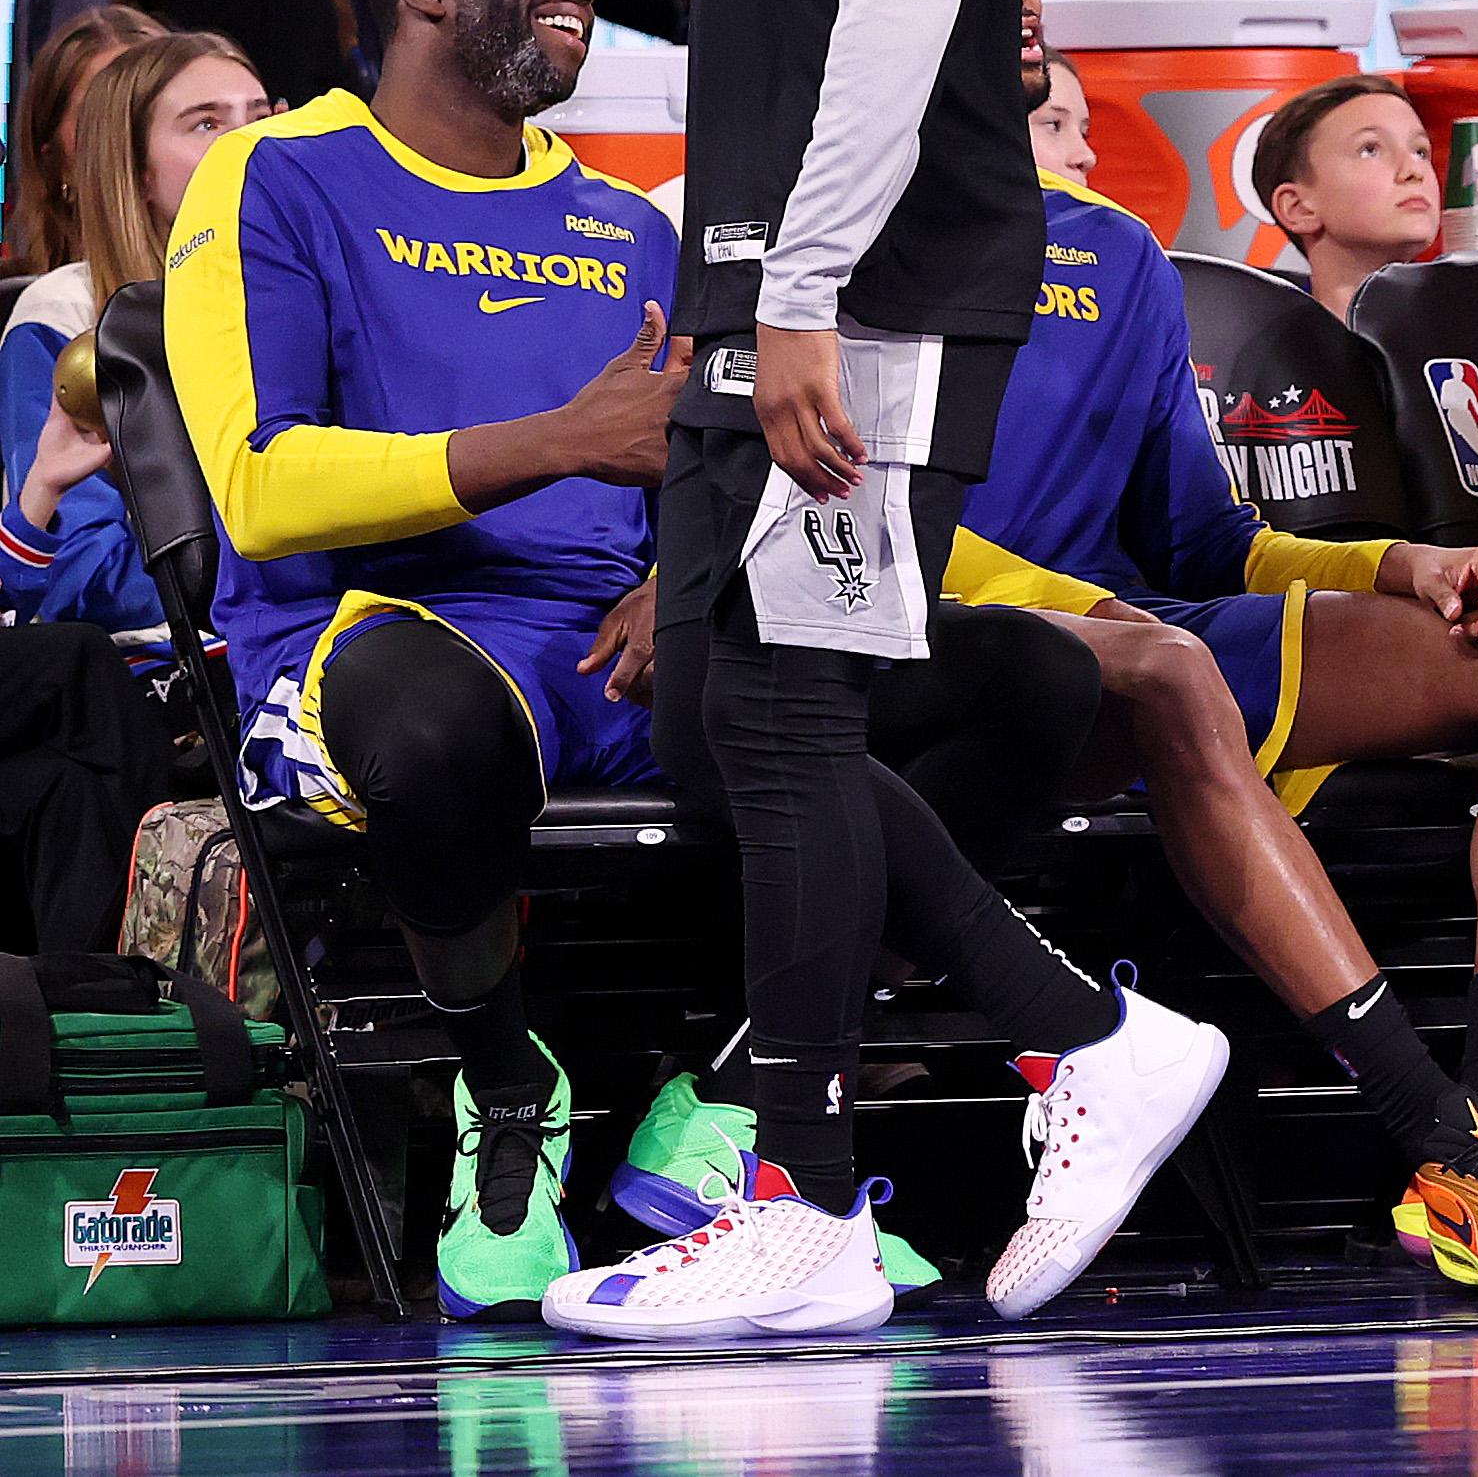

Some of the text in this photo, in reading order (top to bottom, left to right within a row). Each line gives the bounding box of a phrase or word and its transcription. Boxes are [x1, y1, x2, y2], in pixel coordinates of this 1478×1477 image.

[565, 214, 635, 244] Rakuten
[168, 228, 215, 272] Rakuten
[376, 228, 628, 300] WARRIORS
[1255, 439, 1357, 501] NIGHT
[73, 1209, 173, 1244] Gatorade
[79, 1242, 167, 1252] THIRST QUENCHER
